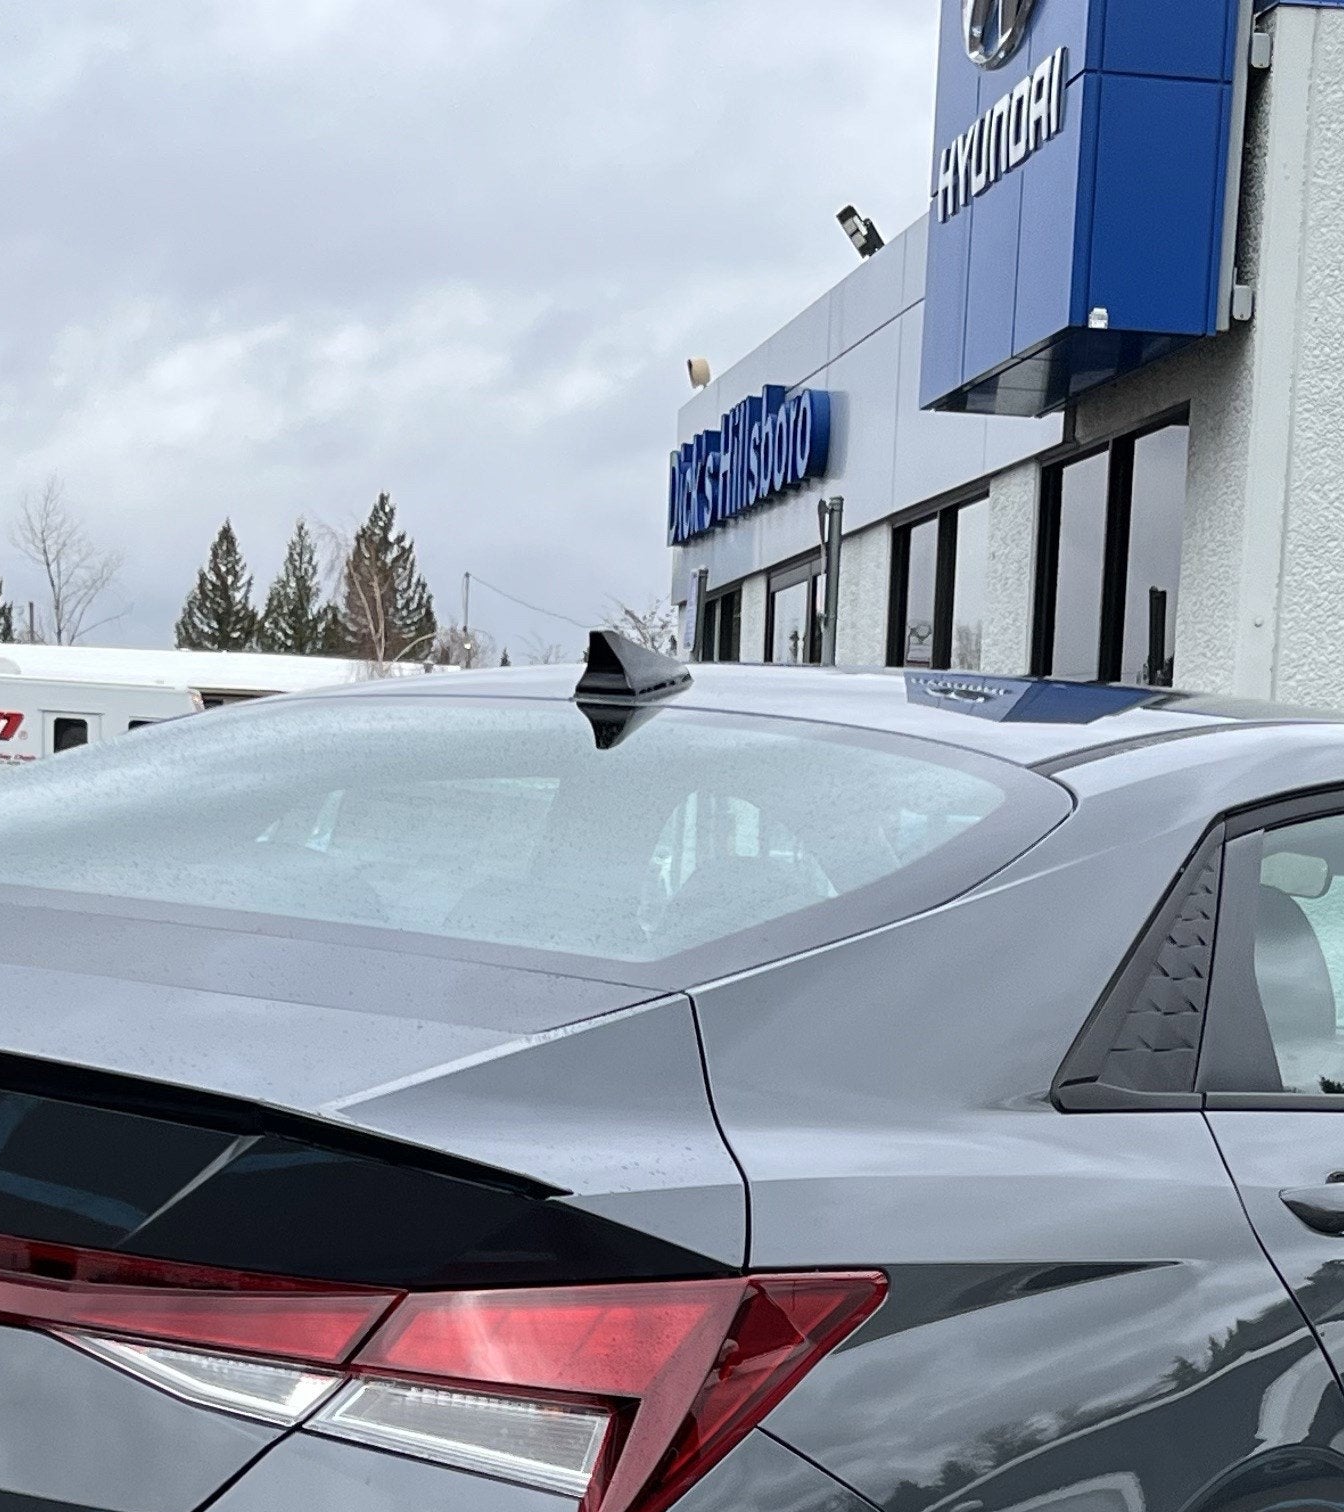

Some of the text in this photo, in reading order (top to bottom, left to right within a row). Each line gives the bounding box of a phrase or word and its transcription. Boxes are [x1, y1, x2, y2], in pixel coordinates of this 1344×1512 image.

[937, 46, 1067, 224] HYUNDAI
[667, 384, 820, 546] Dick's Hillsboro
